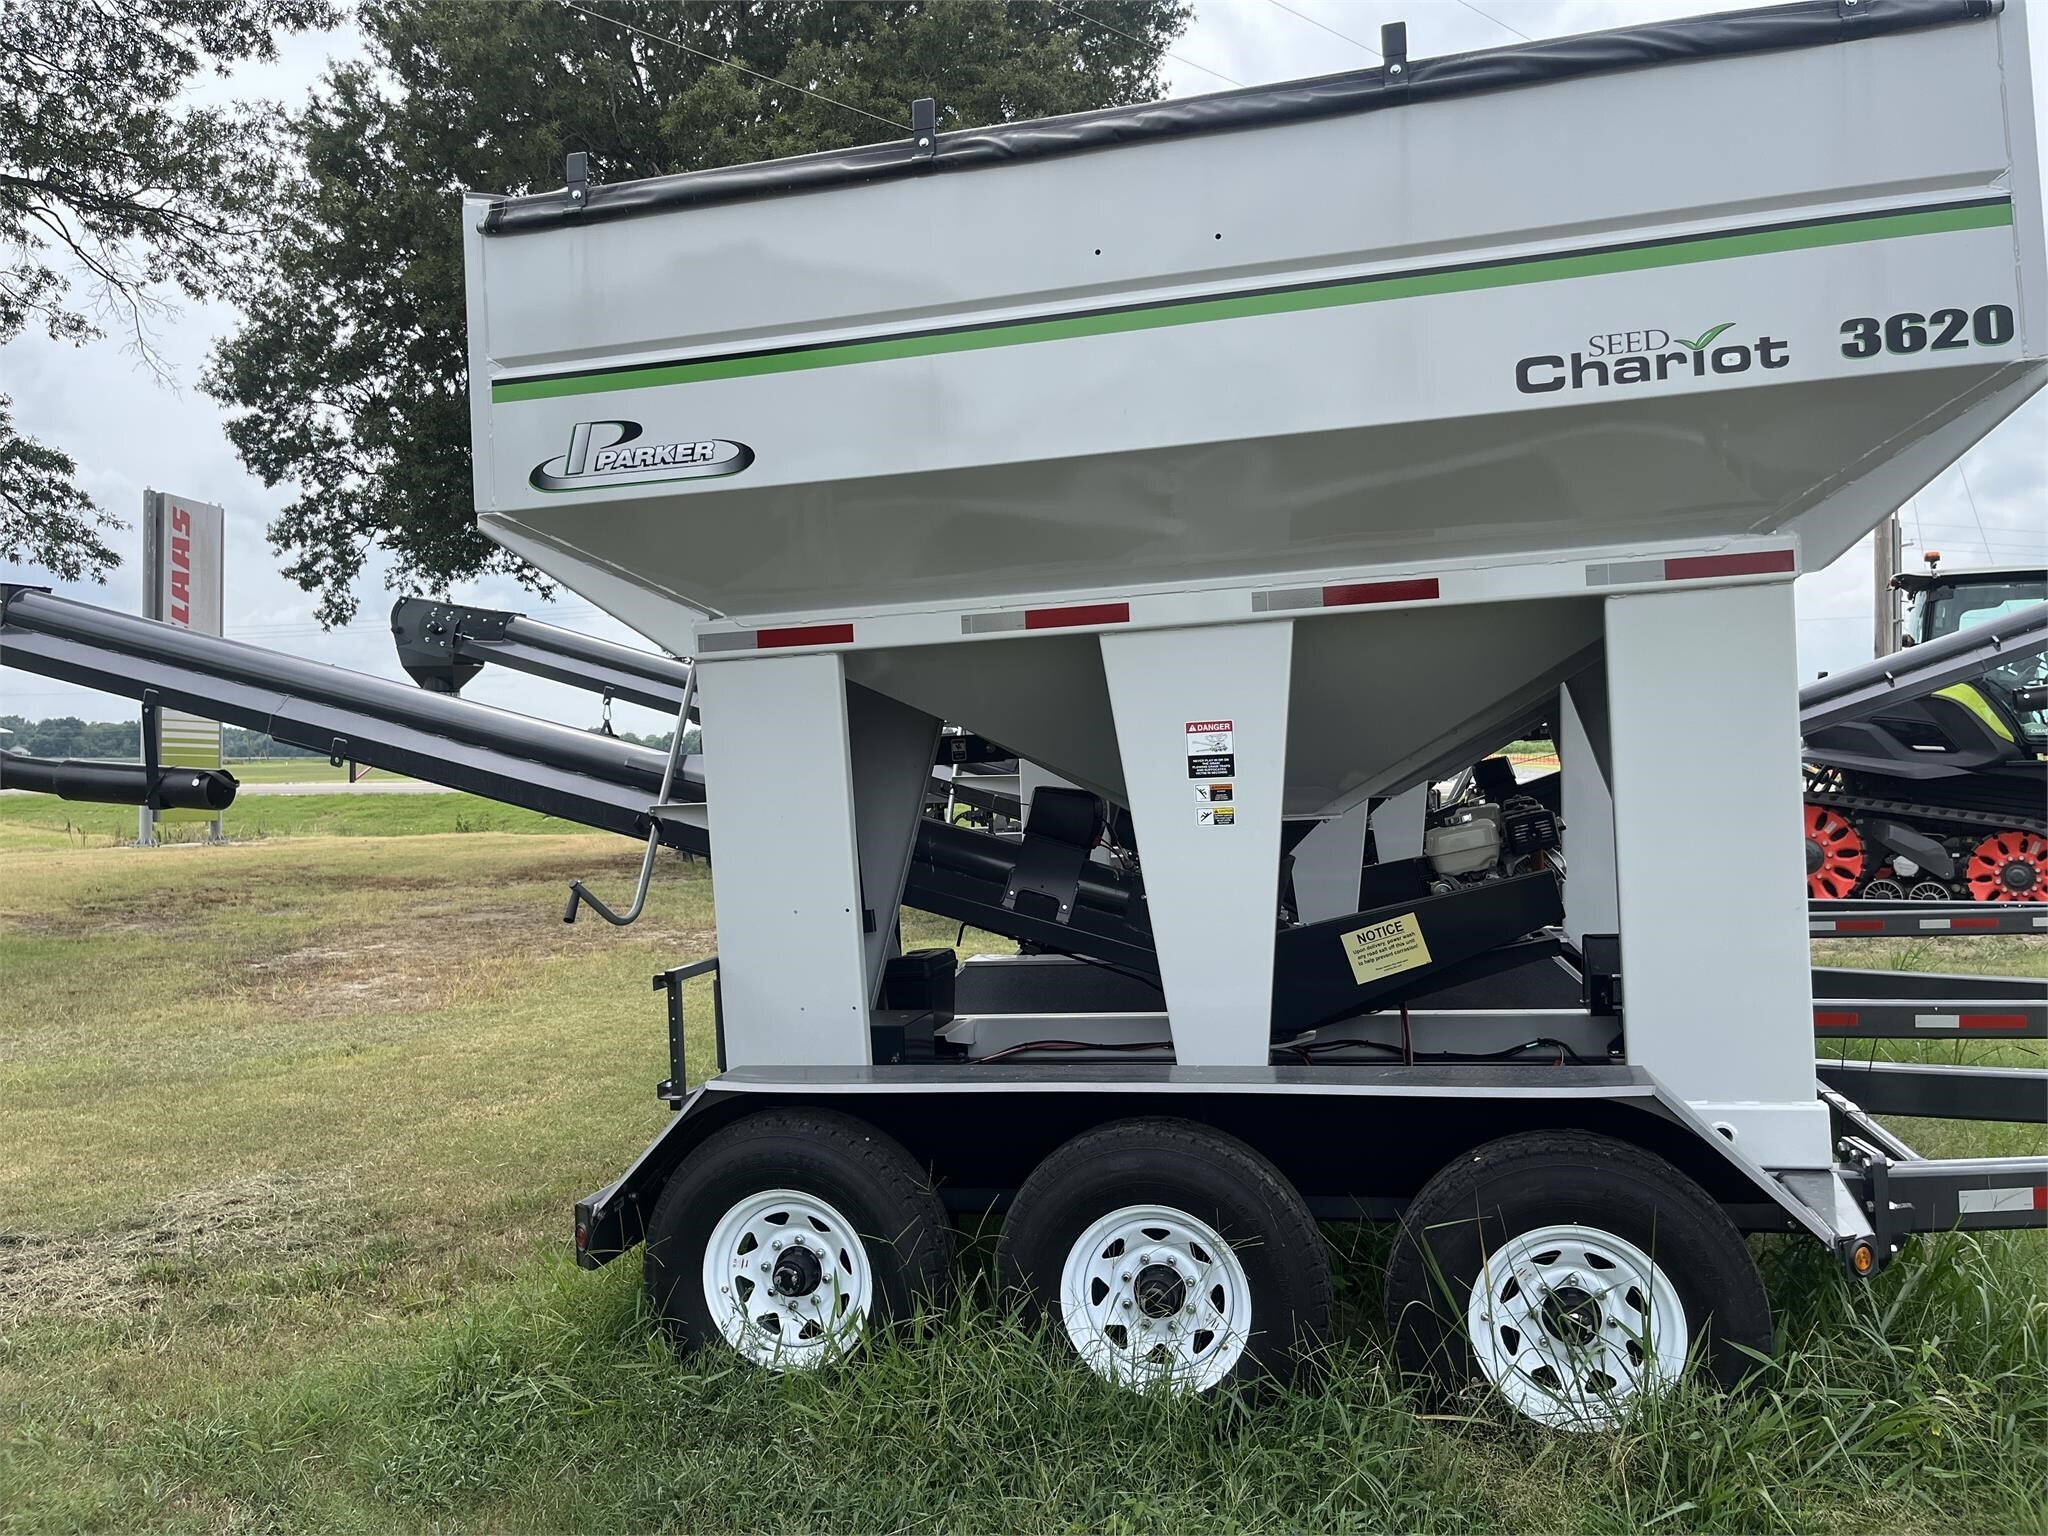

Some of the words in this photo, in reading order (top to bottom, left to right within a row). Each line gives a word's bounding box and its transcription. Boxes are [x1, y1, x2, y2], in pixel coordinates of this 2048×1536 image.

[1588, 329, 1670, 358] SEED
[1840, 304, 2015, 360] 3620
[1515, 335, 1791, 394] Chariot
[595, 440, 716, 471] PARKER
[172, 506, 190, 628] LAAS
[1353, 947, 1366, 955] Upon
[1387, 937, 1402, 945] power
[1403, 932, 1415, 940] wash
[1356, 921, 1404, 944] NOTICE
[1364, 957, 1375, 965] help
[1375, 951, 1394, 962] prevent
[1367, 949, 1378, 957] road
[1379, 946, 1388, 954] salt
